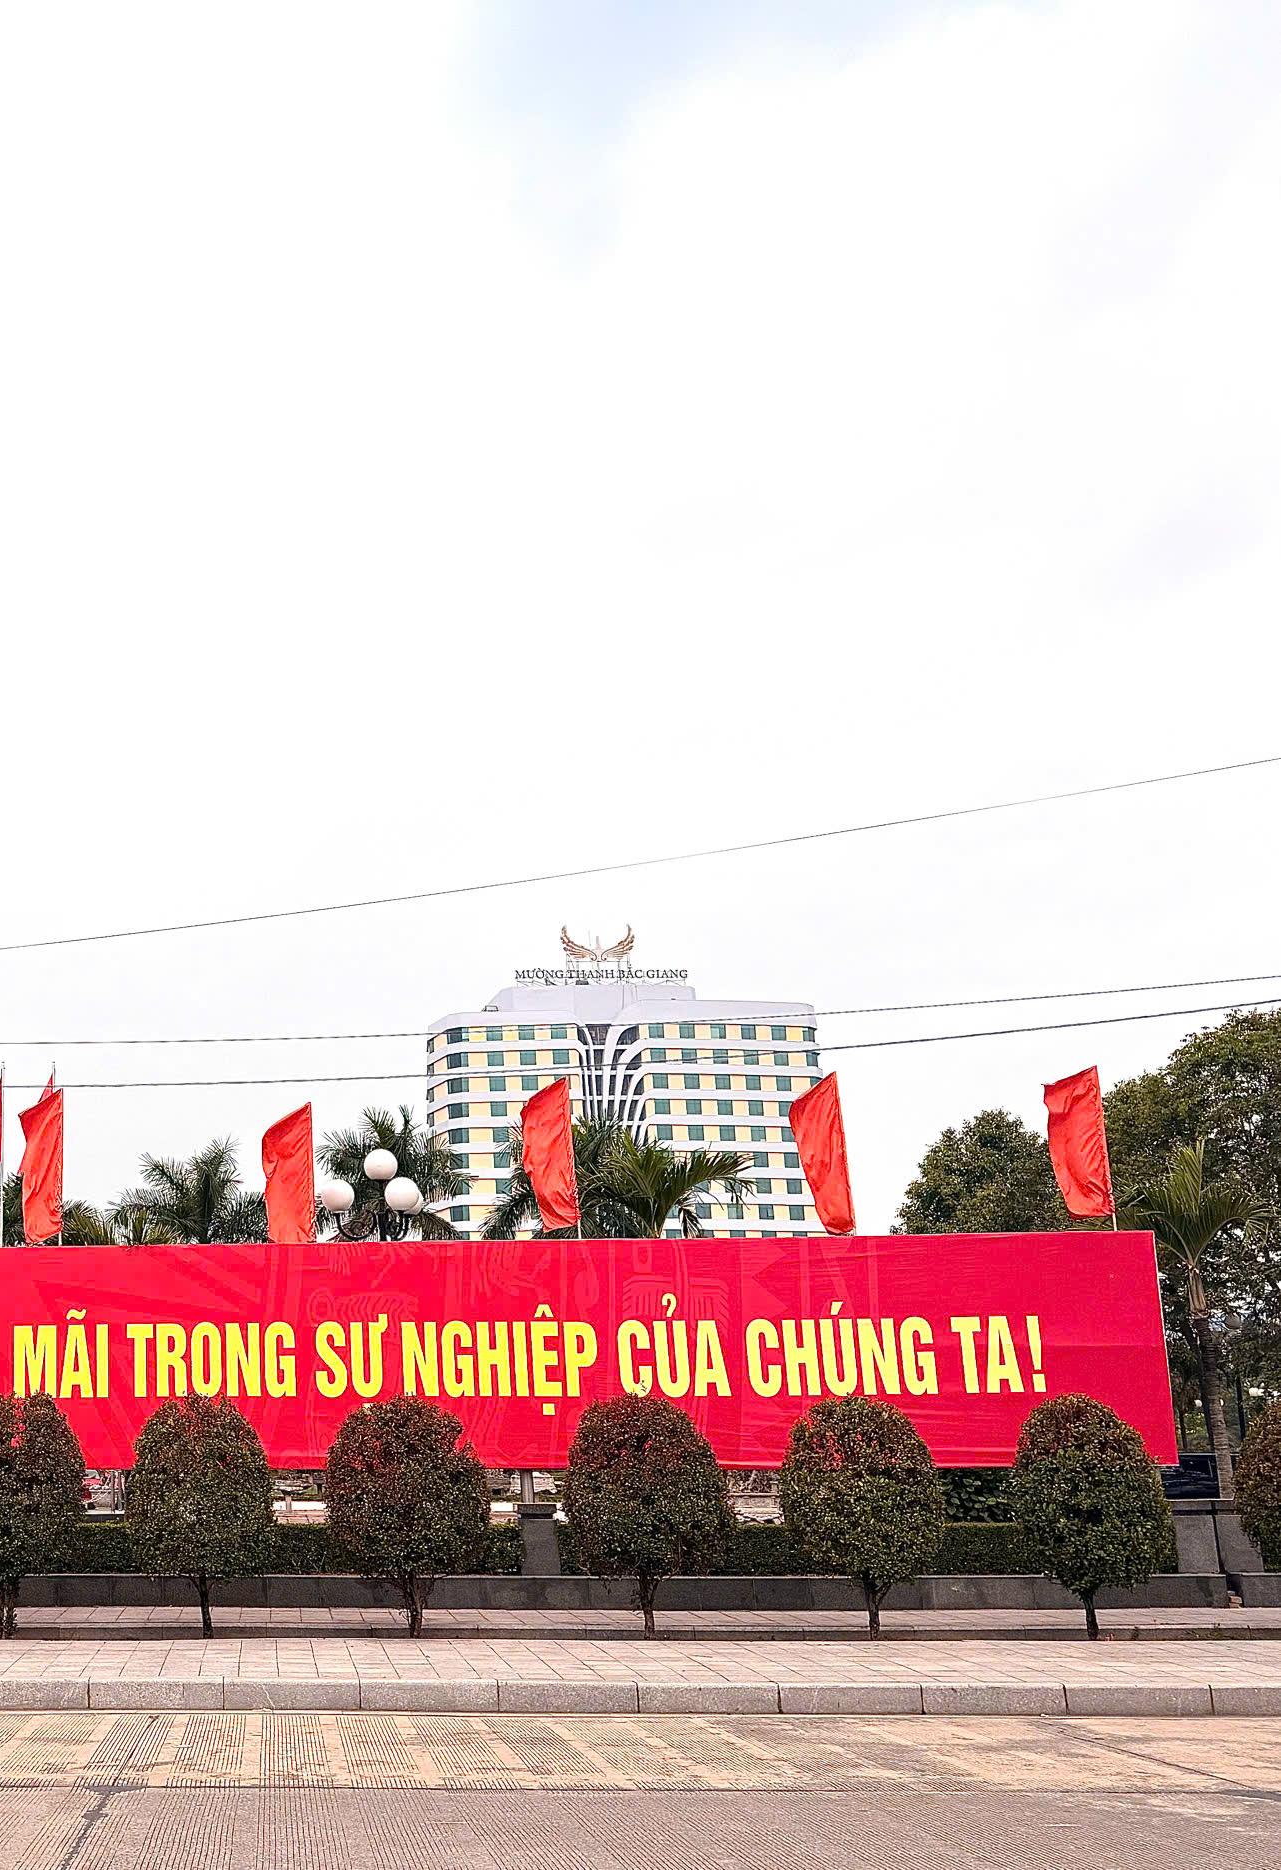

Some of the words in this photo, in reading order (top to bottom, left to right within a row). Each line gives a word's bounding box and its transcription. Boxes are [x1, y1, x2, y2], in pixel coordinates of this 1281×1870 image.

[568, 969, 614, 979] THANH
[646, 969, 688, 979] GIANG
[13, 1308, 109, 1399] MÃI
[126, 1321, 297, 1398] TRONG
[400, 1303, 598, 1416] NGHIỆP
[617, 1293, 732, 1398] CỦA
[745, 1301, 939, 1398] CHÚNG
[950, 1315, 1047, 1394] TA!
